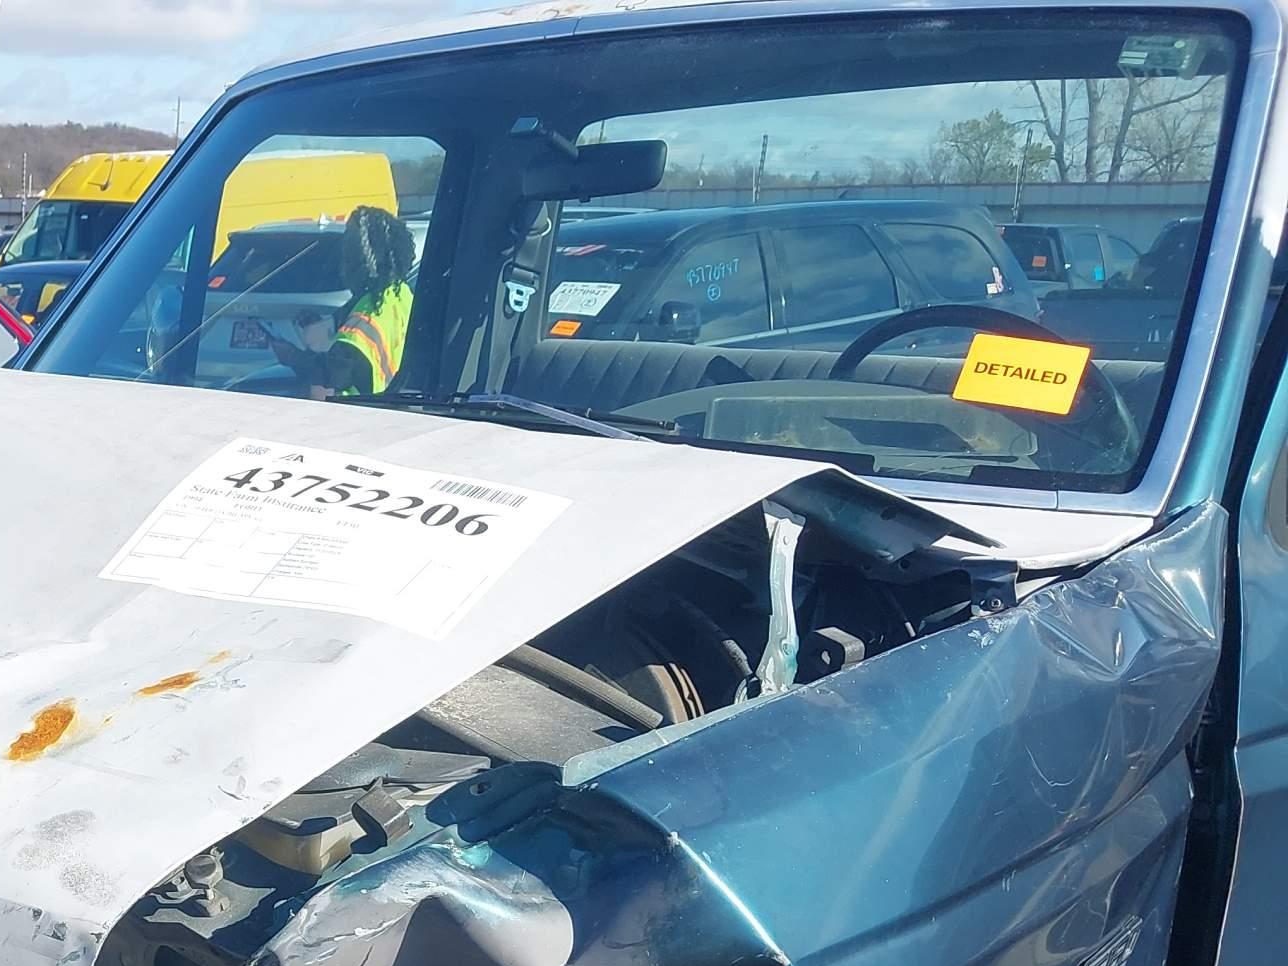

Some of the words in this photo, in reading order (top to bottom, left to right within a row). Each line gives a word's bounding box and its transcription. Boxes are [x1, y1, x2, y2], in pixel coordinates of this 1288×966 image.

[973, 361, 1068, 385] DETAILED
[190, 484, 223, 497] State
[225, 490, 259, 502] Farm
[262, 495, 327, 514] Insurance
[223, 467, 501, 535] 43752206
